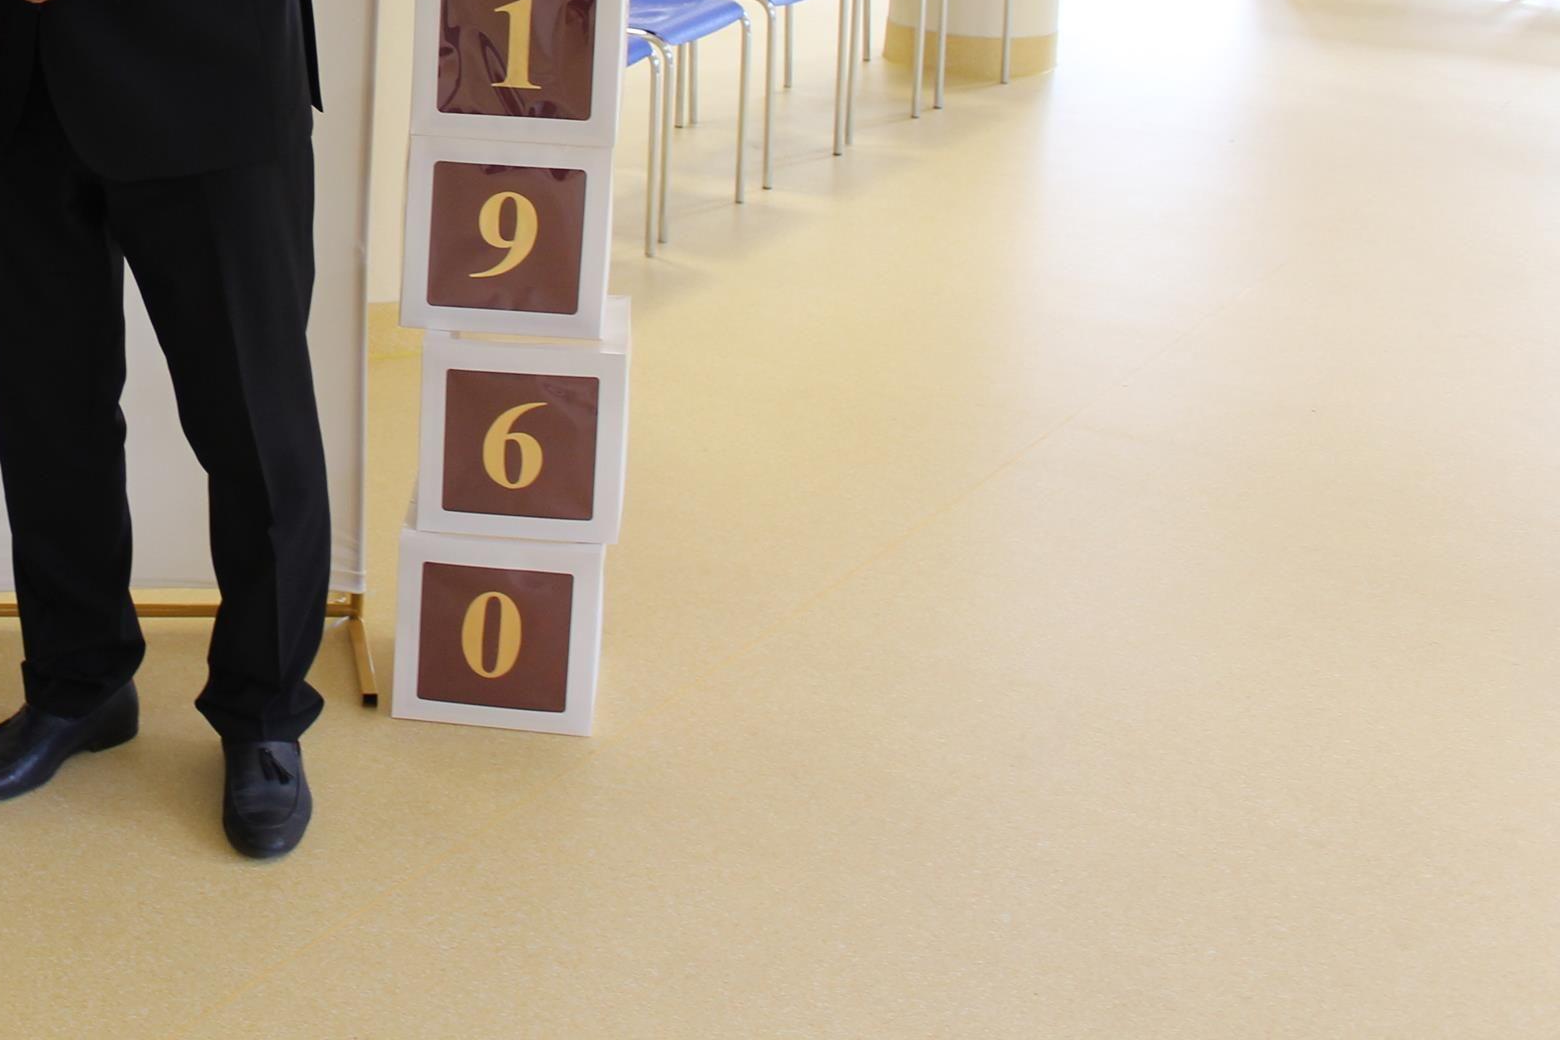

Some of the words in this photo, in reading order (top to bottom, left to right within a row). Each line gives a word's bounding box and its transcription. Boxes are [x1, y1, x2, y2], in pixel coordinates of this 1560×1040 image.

[468, 191, 538, 278] 9
[482, 402, 548, 489] 6
[461, 591, 522, 679] 0
